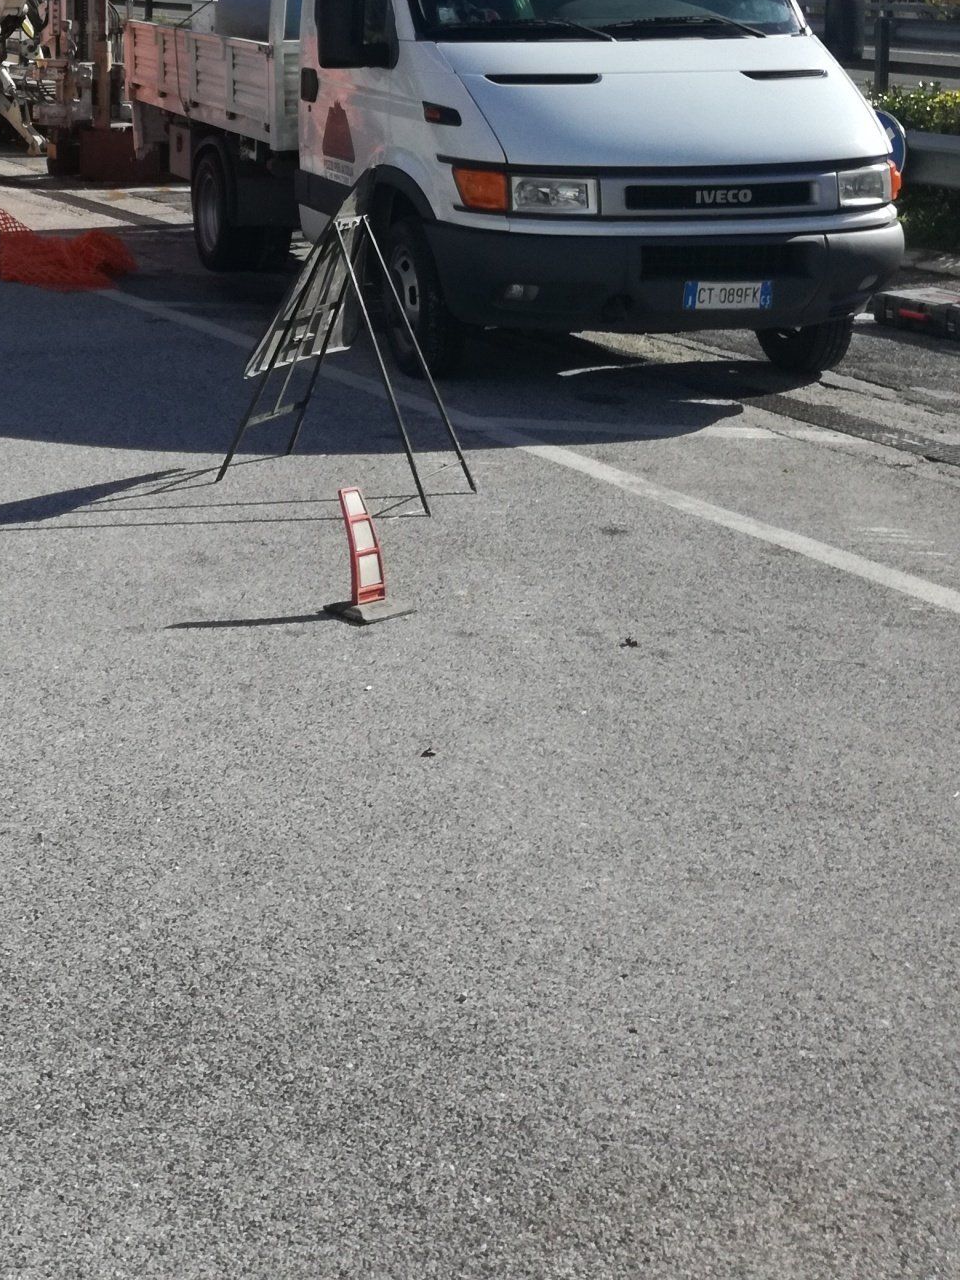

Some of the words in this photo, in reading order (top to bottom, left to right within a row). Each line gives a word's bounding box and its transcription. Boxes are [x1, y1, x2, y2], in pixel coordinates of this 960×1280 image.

[695, 189, 753, 204] IVECO
[698, 287, 715, 304] CT
[719, 287, 759, 303] 089FK
